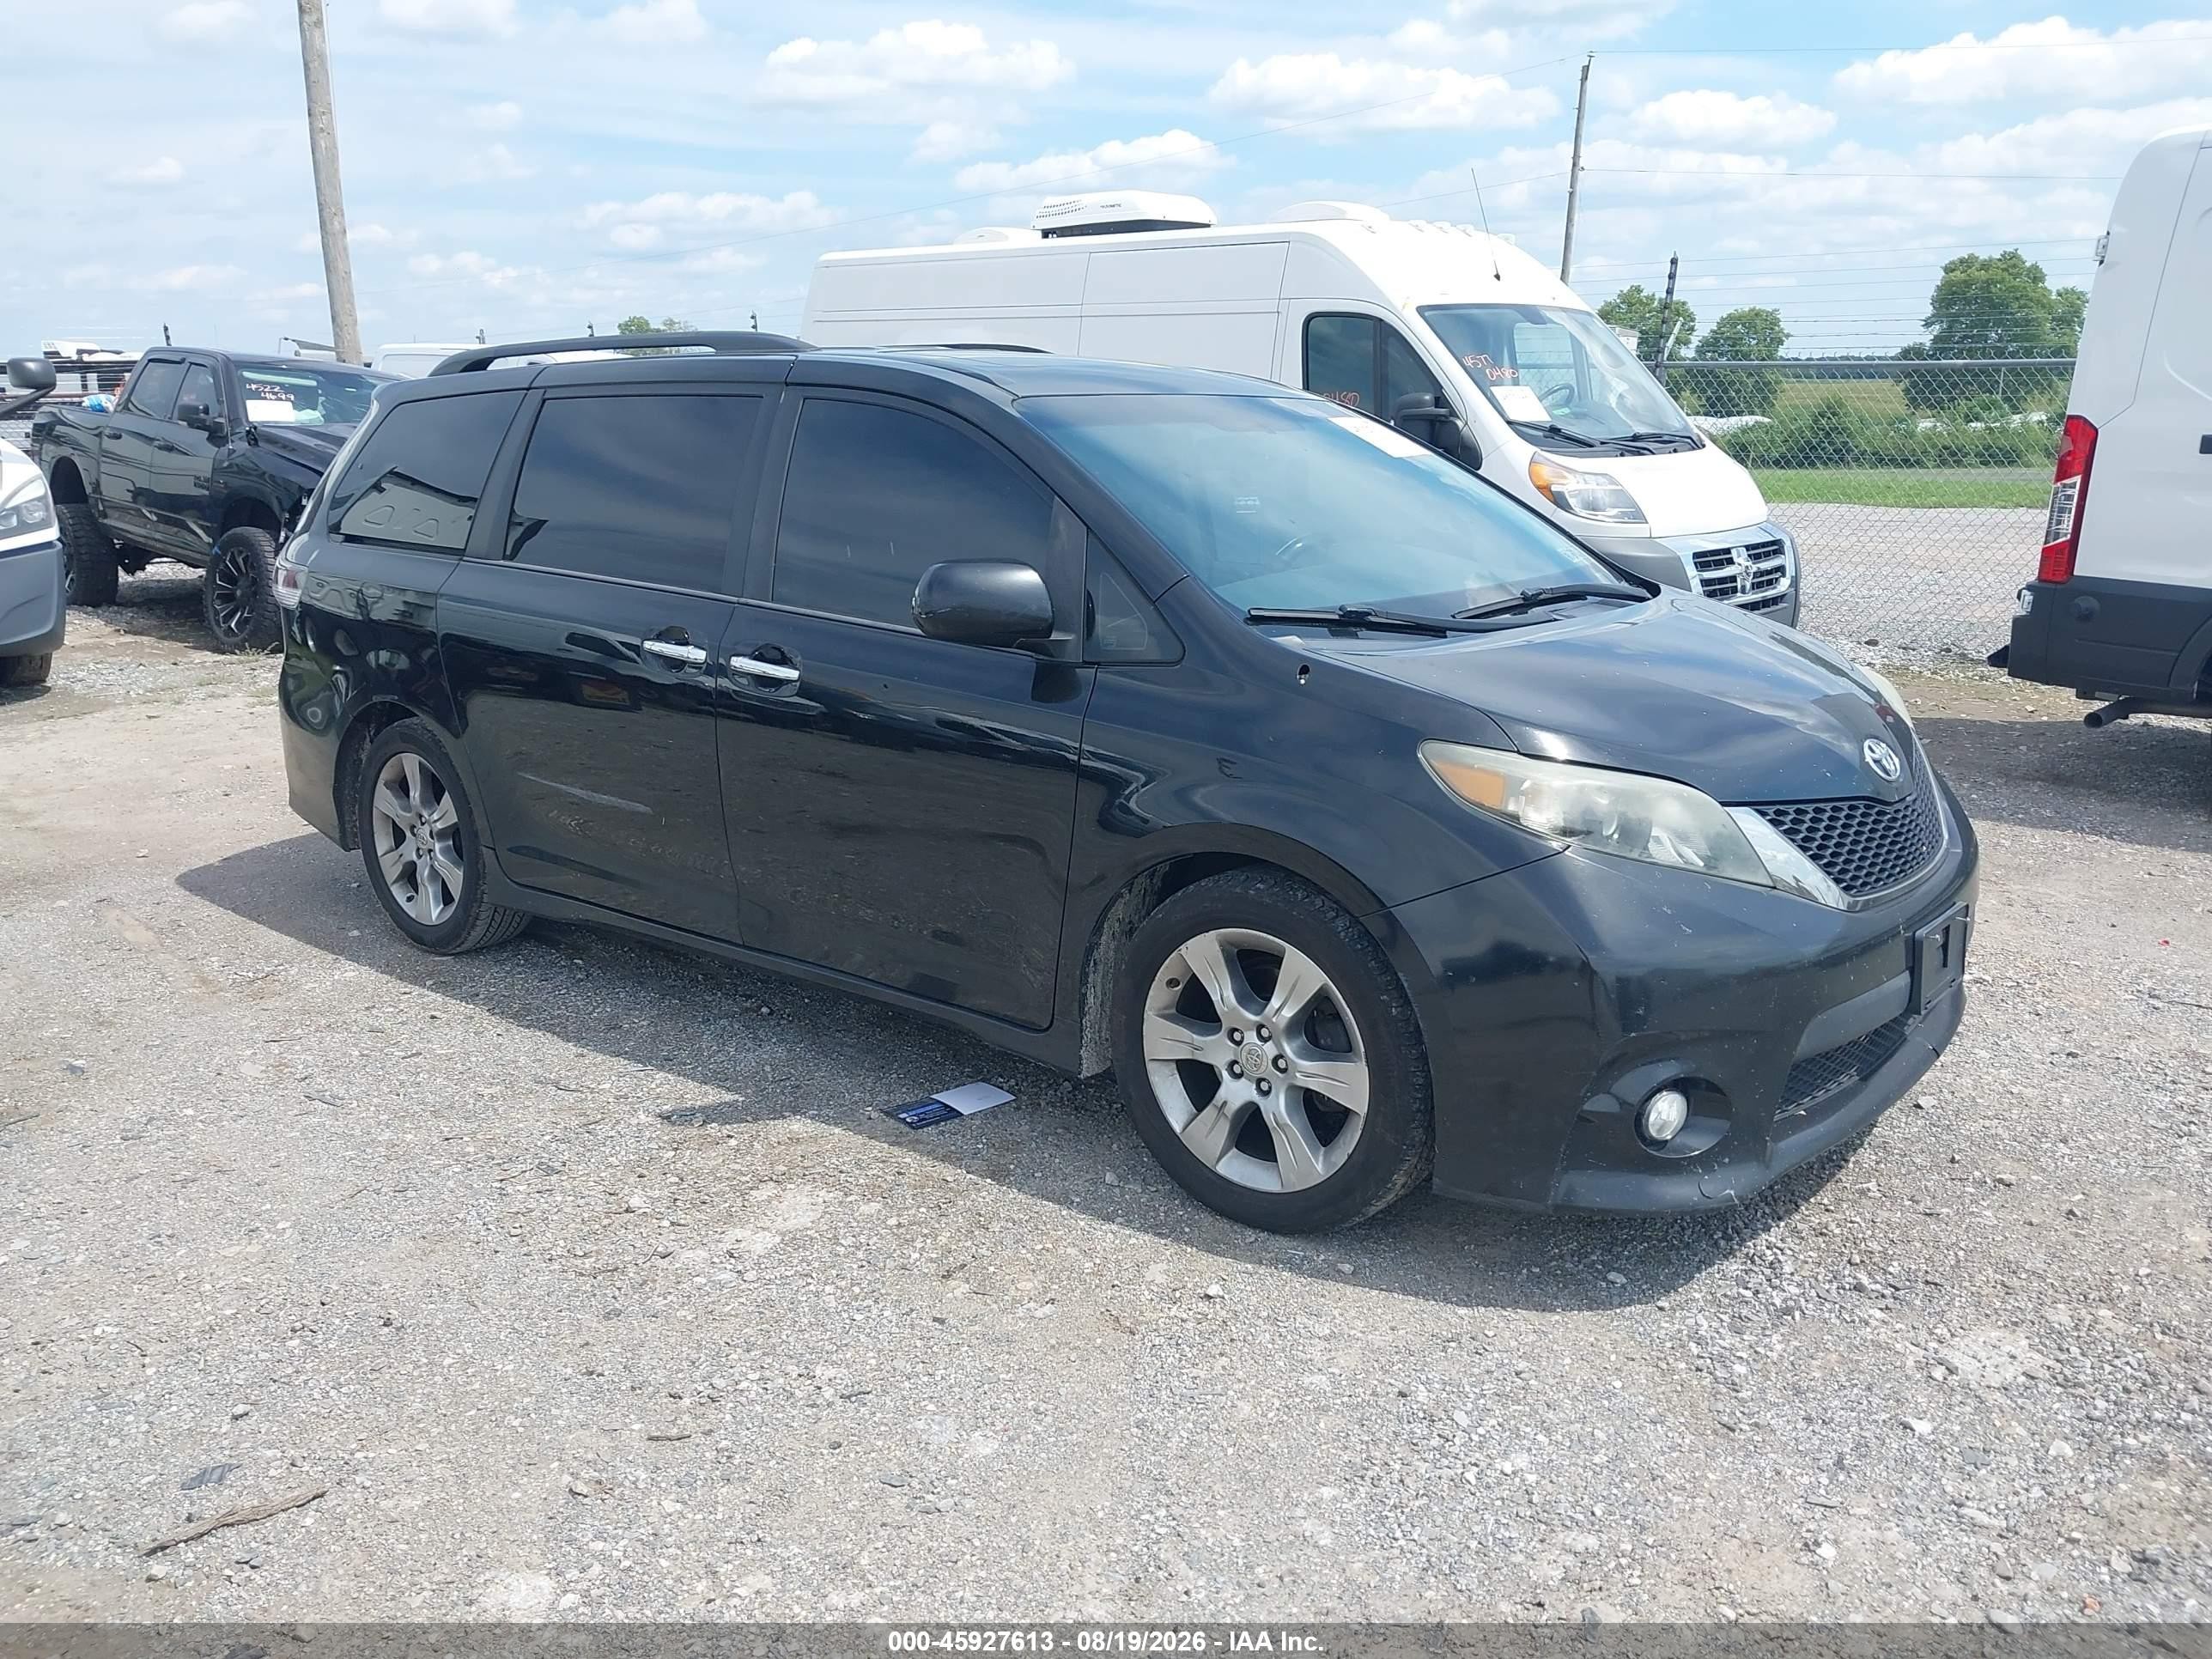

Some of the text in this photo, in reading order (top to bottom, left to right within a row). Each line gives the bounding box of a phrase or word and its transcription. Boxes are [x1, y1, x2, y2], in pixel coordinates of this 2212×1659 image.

[1486, 367, 1519, 380] 0480
[246, 383, 285, 392] 4522
[260, 392, 295, 401] 4699
